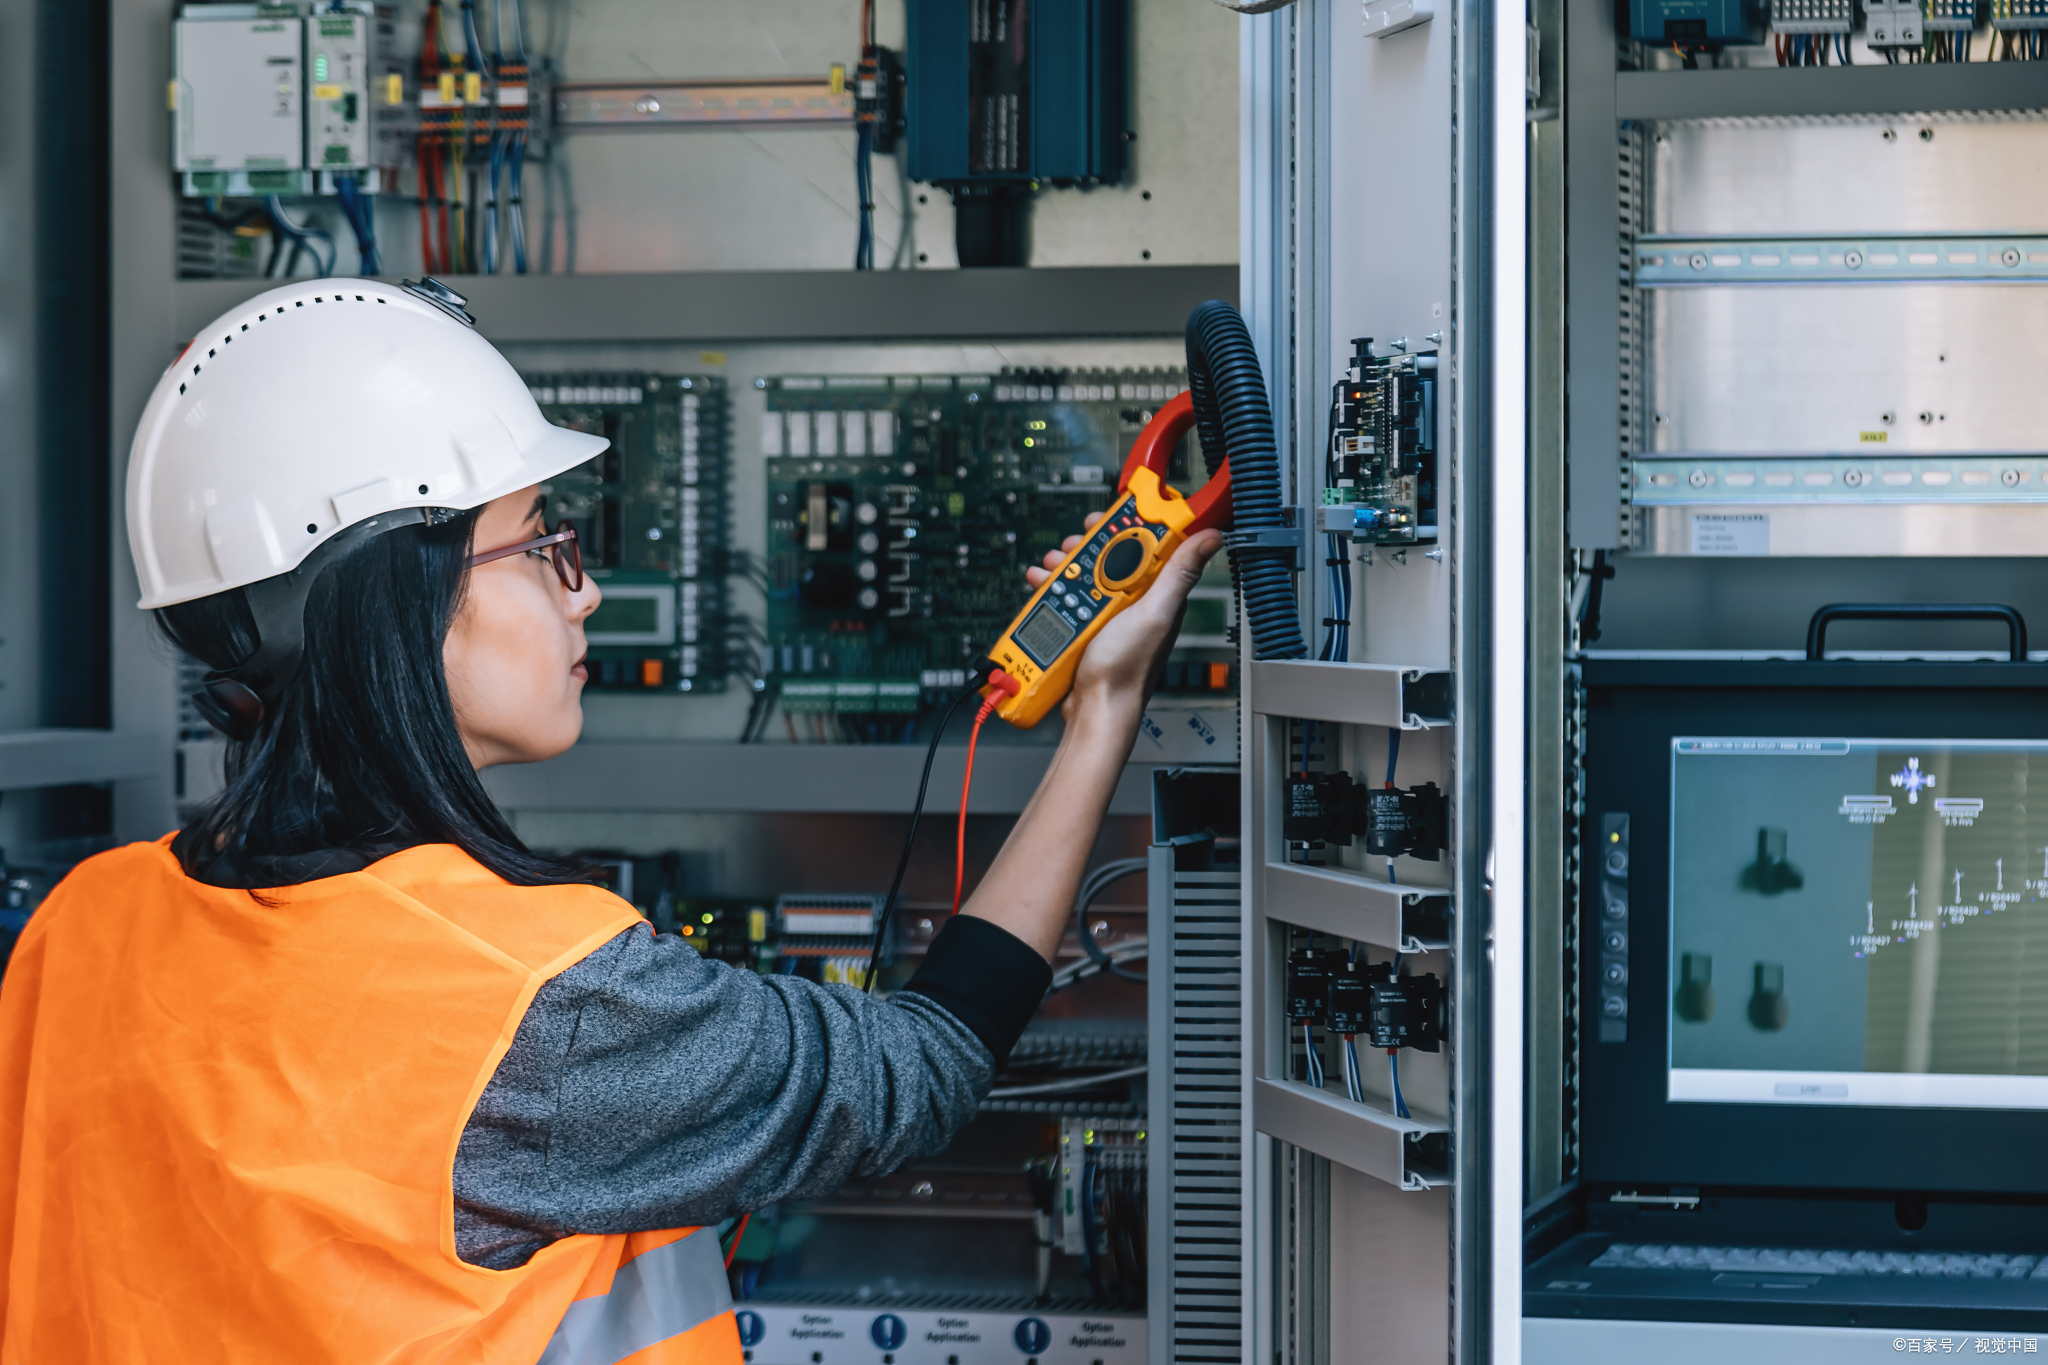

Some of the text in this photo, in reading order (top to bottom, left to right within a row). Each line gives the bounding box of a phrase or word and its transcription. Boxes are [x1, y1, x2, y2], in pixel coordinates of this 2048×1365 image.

[1890, 774, 1903, 787] W
[802, 1314, 833, 1326] Option
[938, 1318, 969, 1330] Option
[790, 1327, 844, 1341] Application
[1083, 1321, 1115, 1334] Option
[927, 1331, 981, 1345] Application
[1071, 1336, 1126, 1349] Application
